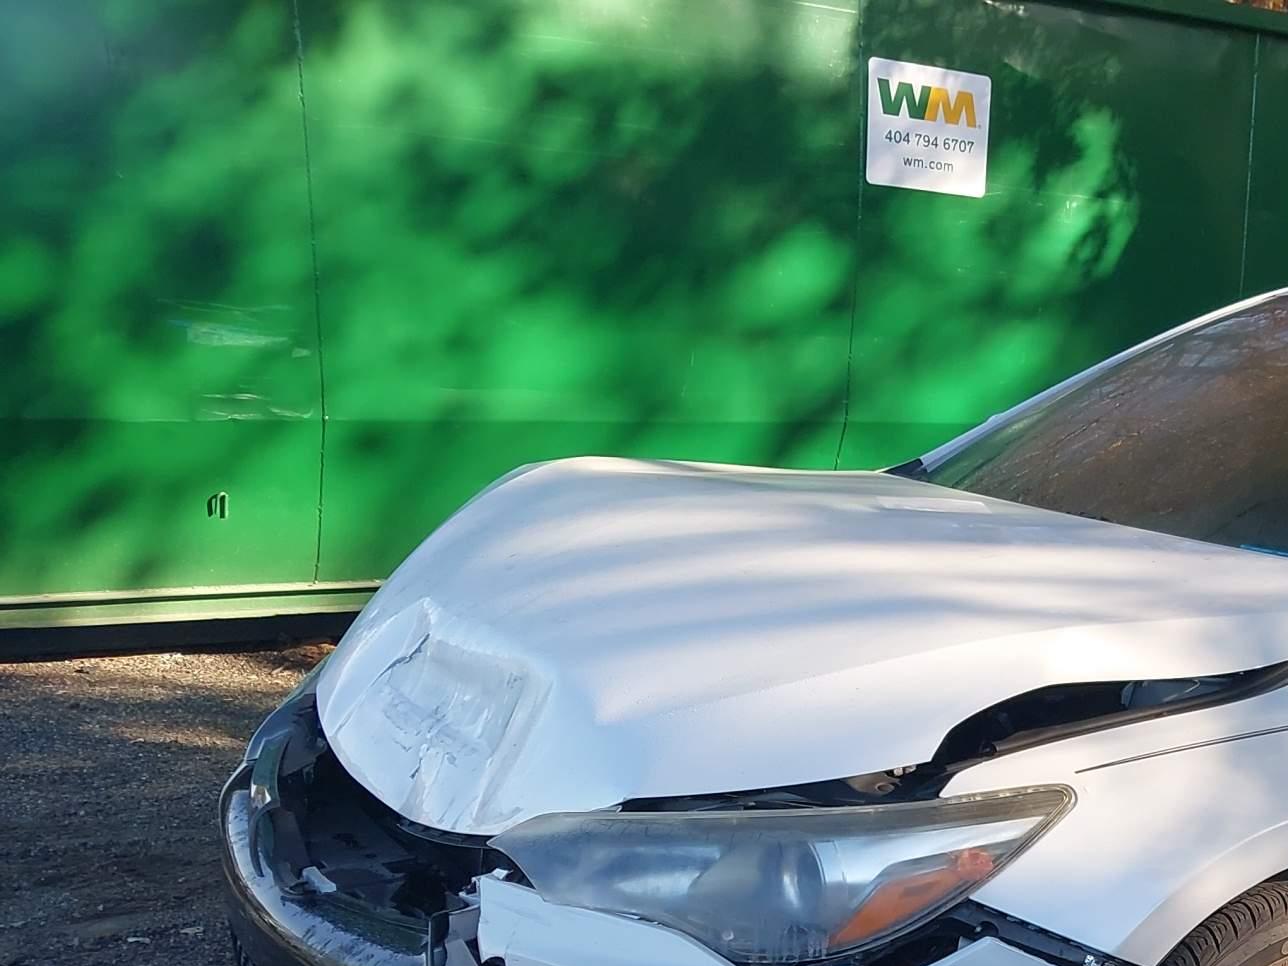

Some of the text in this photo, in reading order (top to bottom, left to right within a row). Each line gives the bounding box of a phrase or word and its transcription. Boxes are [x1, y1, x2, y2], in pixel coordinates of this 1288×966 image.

[877, 77, 977, 129] WM
[885, 129, 975, 154] 404 794 6707
[903, 156, 954, 173] wm.com
